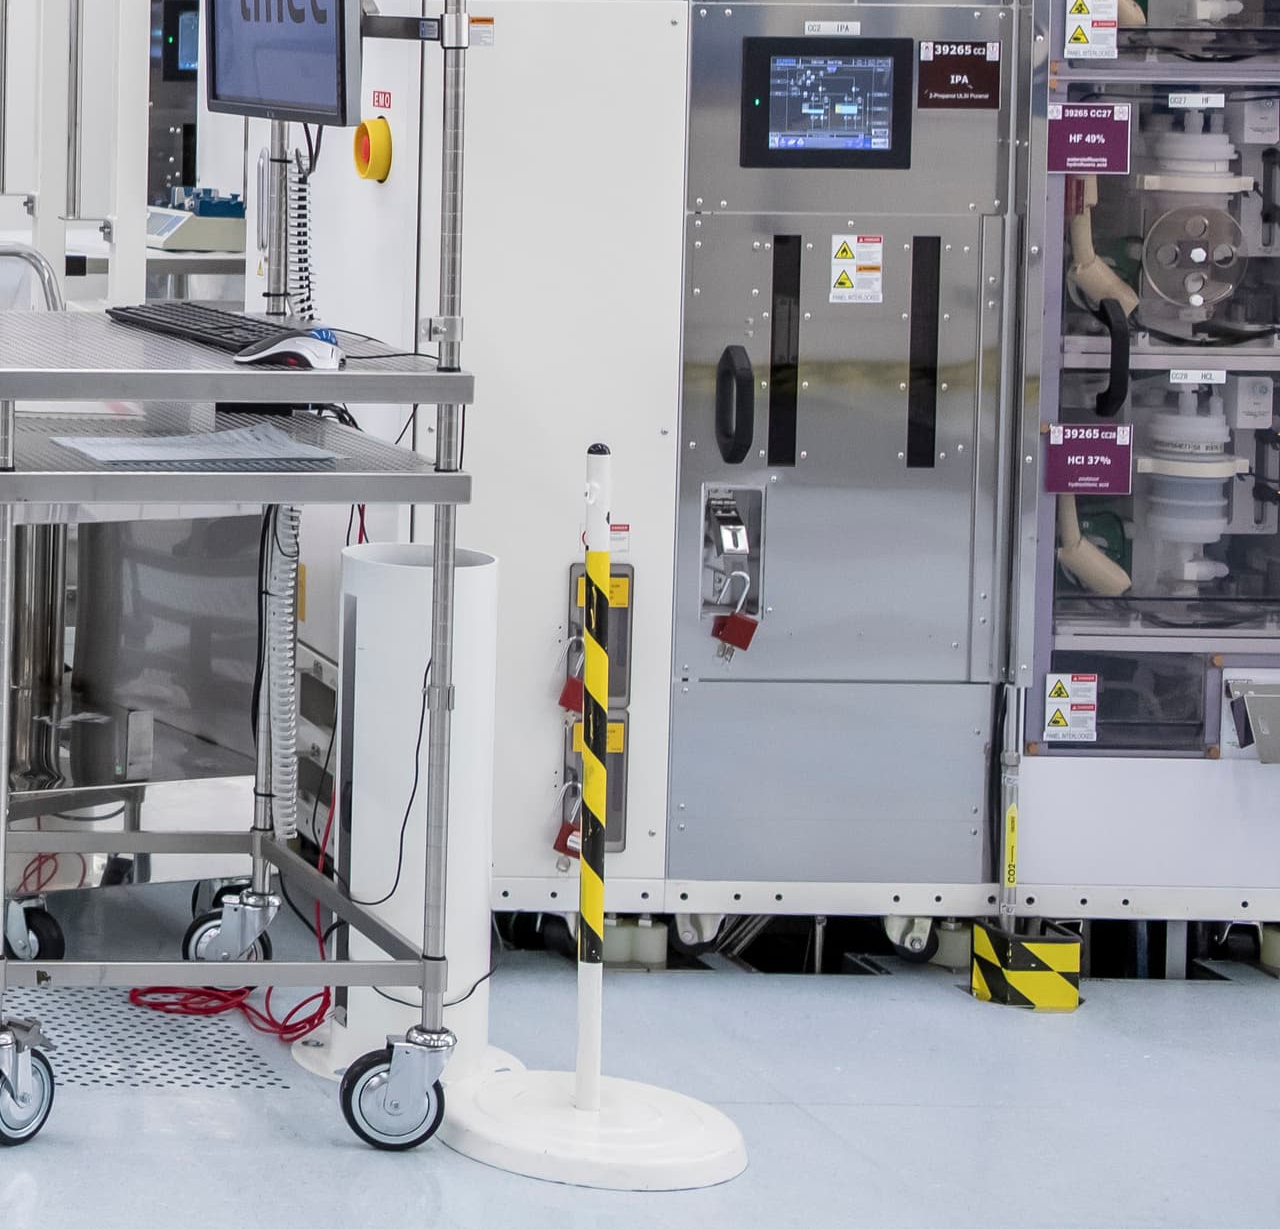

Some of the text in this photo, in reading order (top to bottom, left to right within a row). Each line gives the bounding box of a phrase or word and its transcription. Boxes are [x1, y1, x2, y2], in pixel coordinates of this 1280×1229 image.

[934, 44, 972, 56] 39265
[949, 74, 969, 84] IPA
[374, 92, 390, 108] EMO
[1090, 109, 1112, 118] CC27
[1069, 134, 1106, 144] HF 49%
[1064, 428, 1100, 439] 39265
[1087, 455, 1112, 465] 37%
[1007, 863, 1016, 884] CO2
